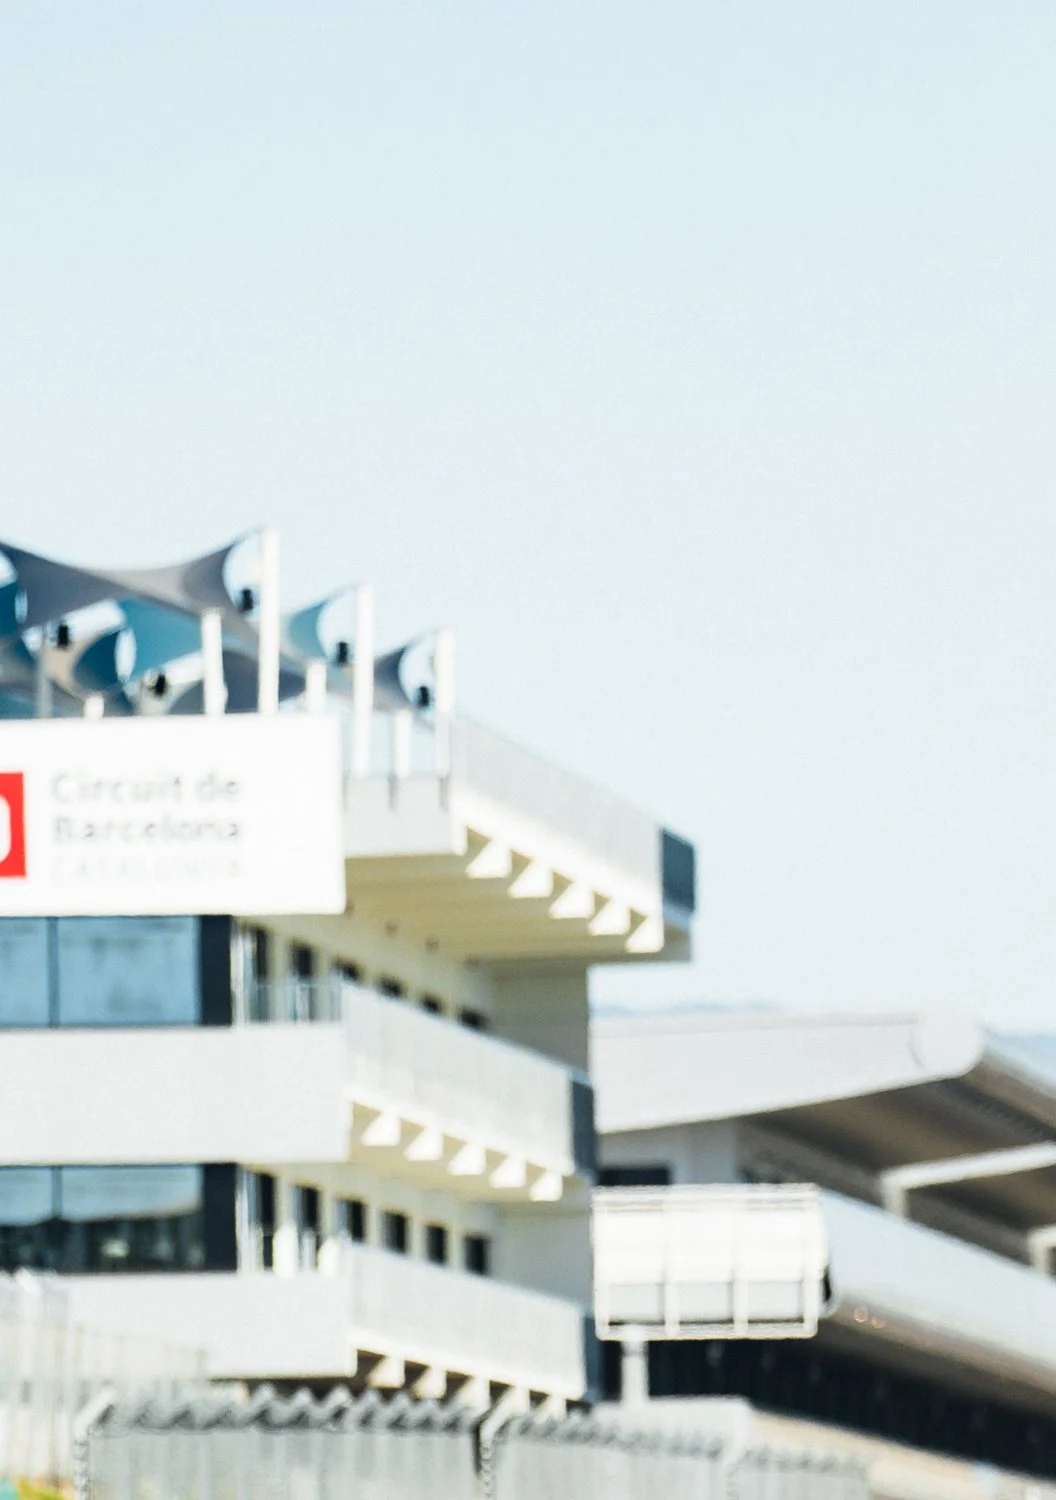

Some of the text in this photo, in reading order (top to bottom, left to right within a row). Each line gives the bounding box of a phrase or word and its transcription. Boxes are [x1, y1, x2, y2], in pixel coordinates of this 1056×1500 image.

[52, 770, 240, 803] Circuit de
[53, 815, 241, 843] Barcelona
